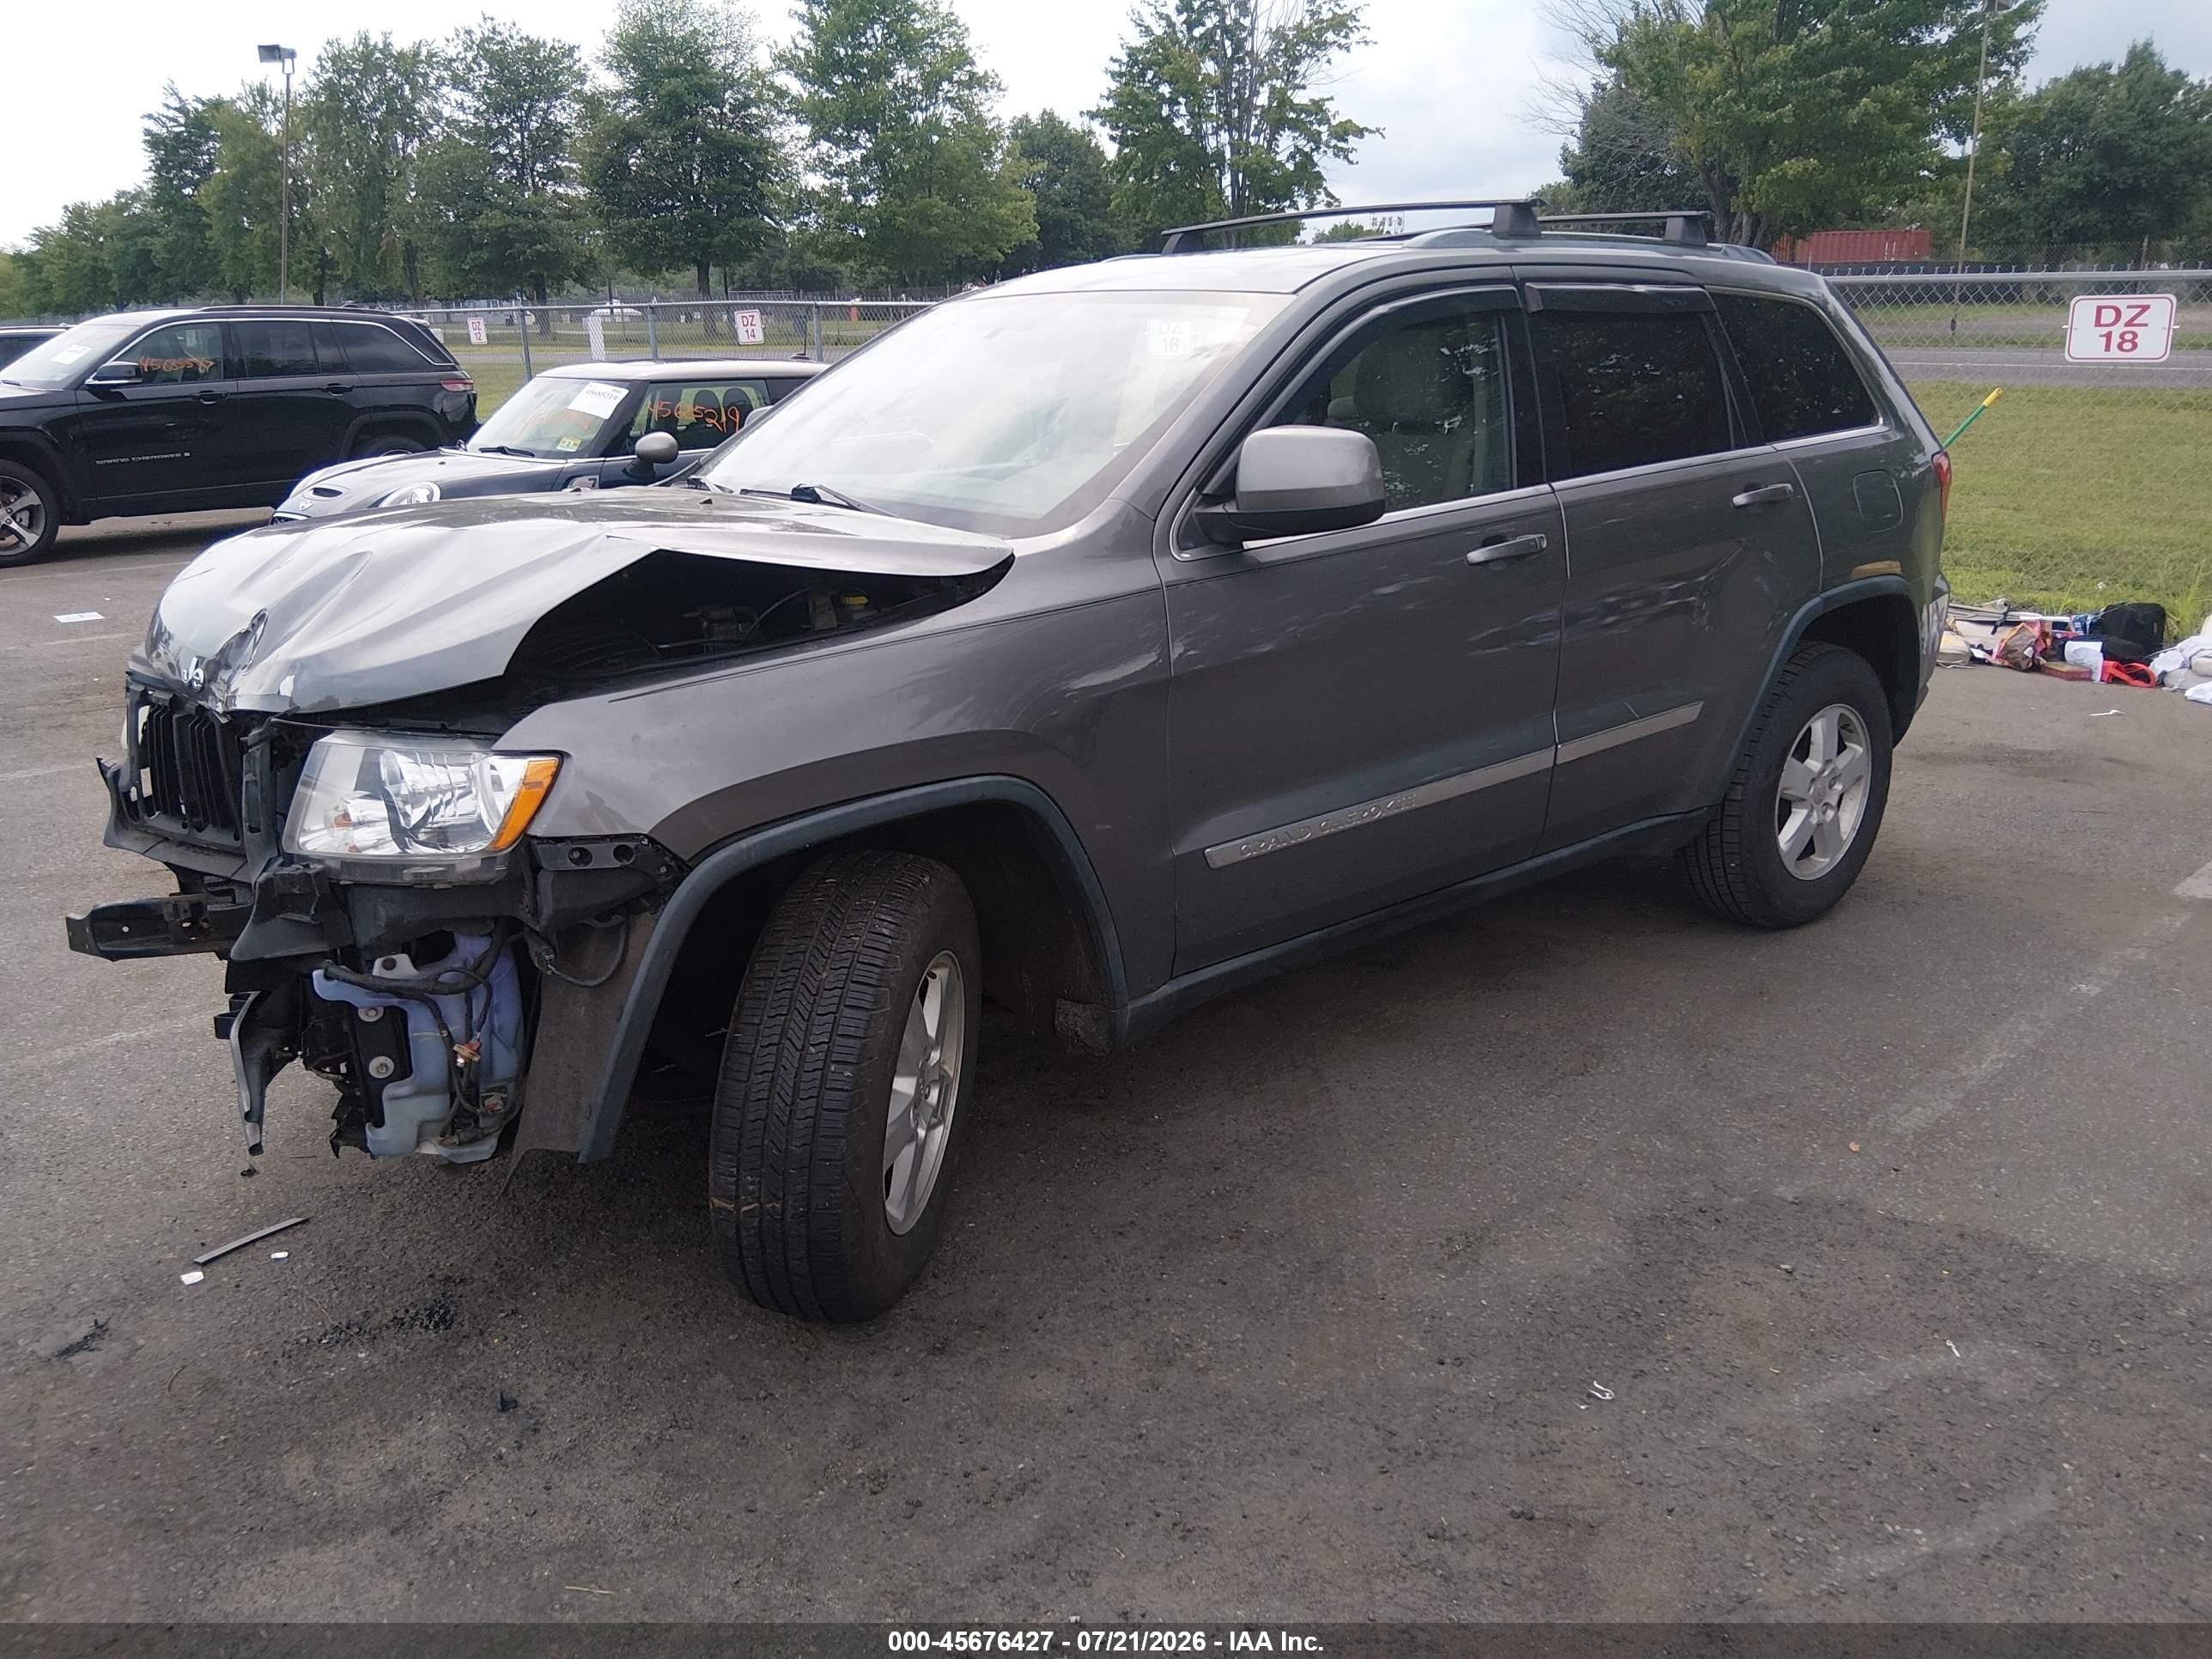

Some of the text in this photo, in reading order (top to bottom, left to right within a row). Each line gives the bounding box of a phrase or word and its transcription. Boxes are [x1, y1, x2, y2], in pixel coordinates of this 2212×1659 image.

[741, 314, 756, 327] DZ
[2094, 304, 2151, 327] DZ
[471, 321, 482, 331] DZ
[474, 331, 482, 341] 12
[745, 329, 756, 340] 14
[1161, 336, 1181, 354] 16
[2099, 330, 2139, 353] 18
